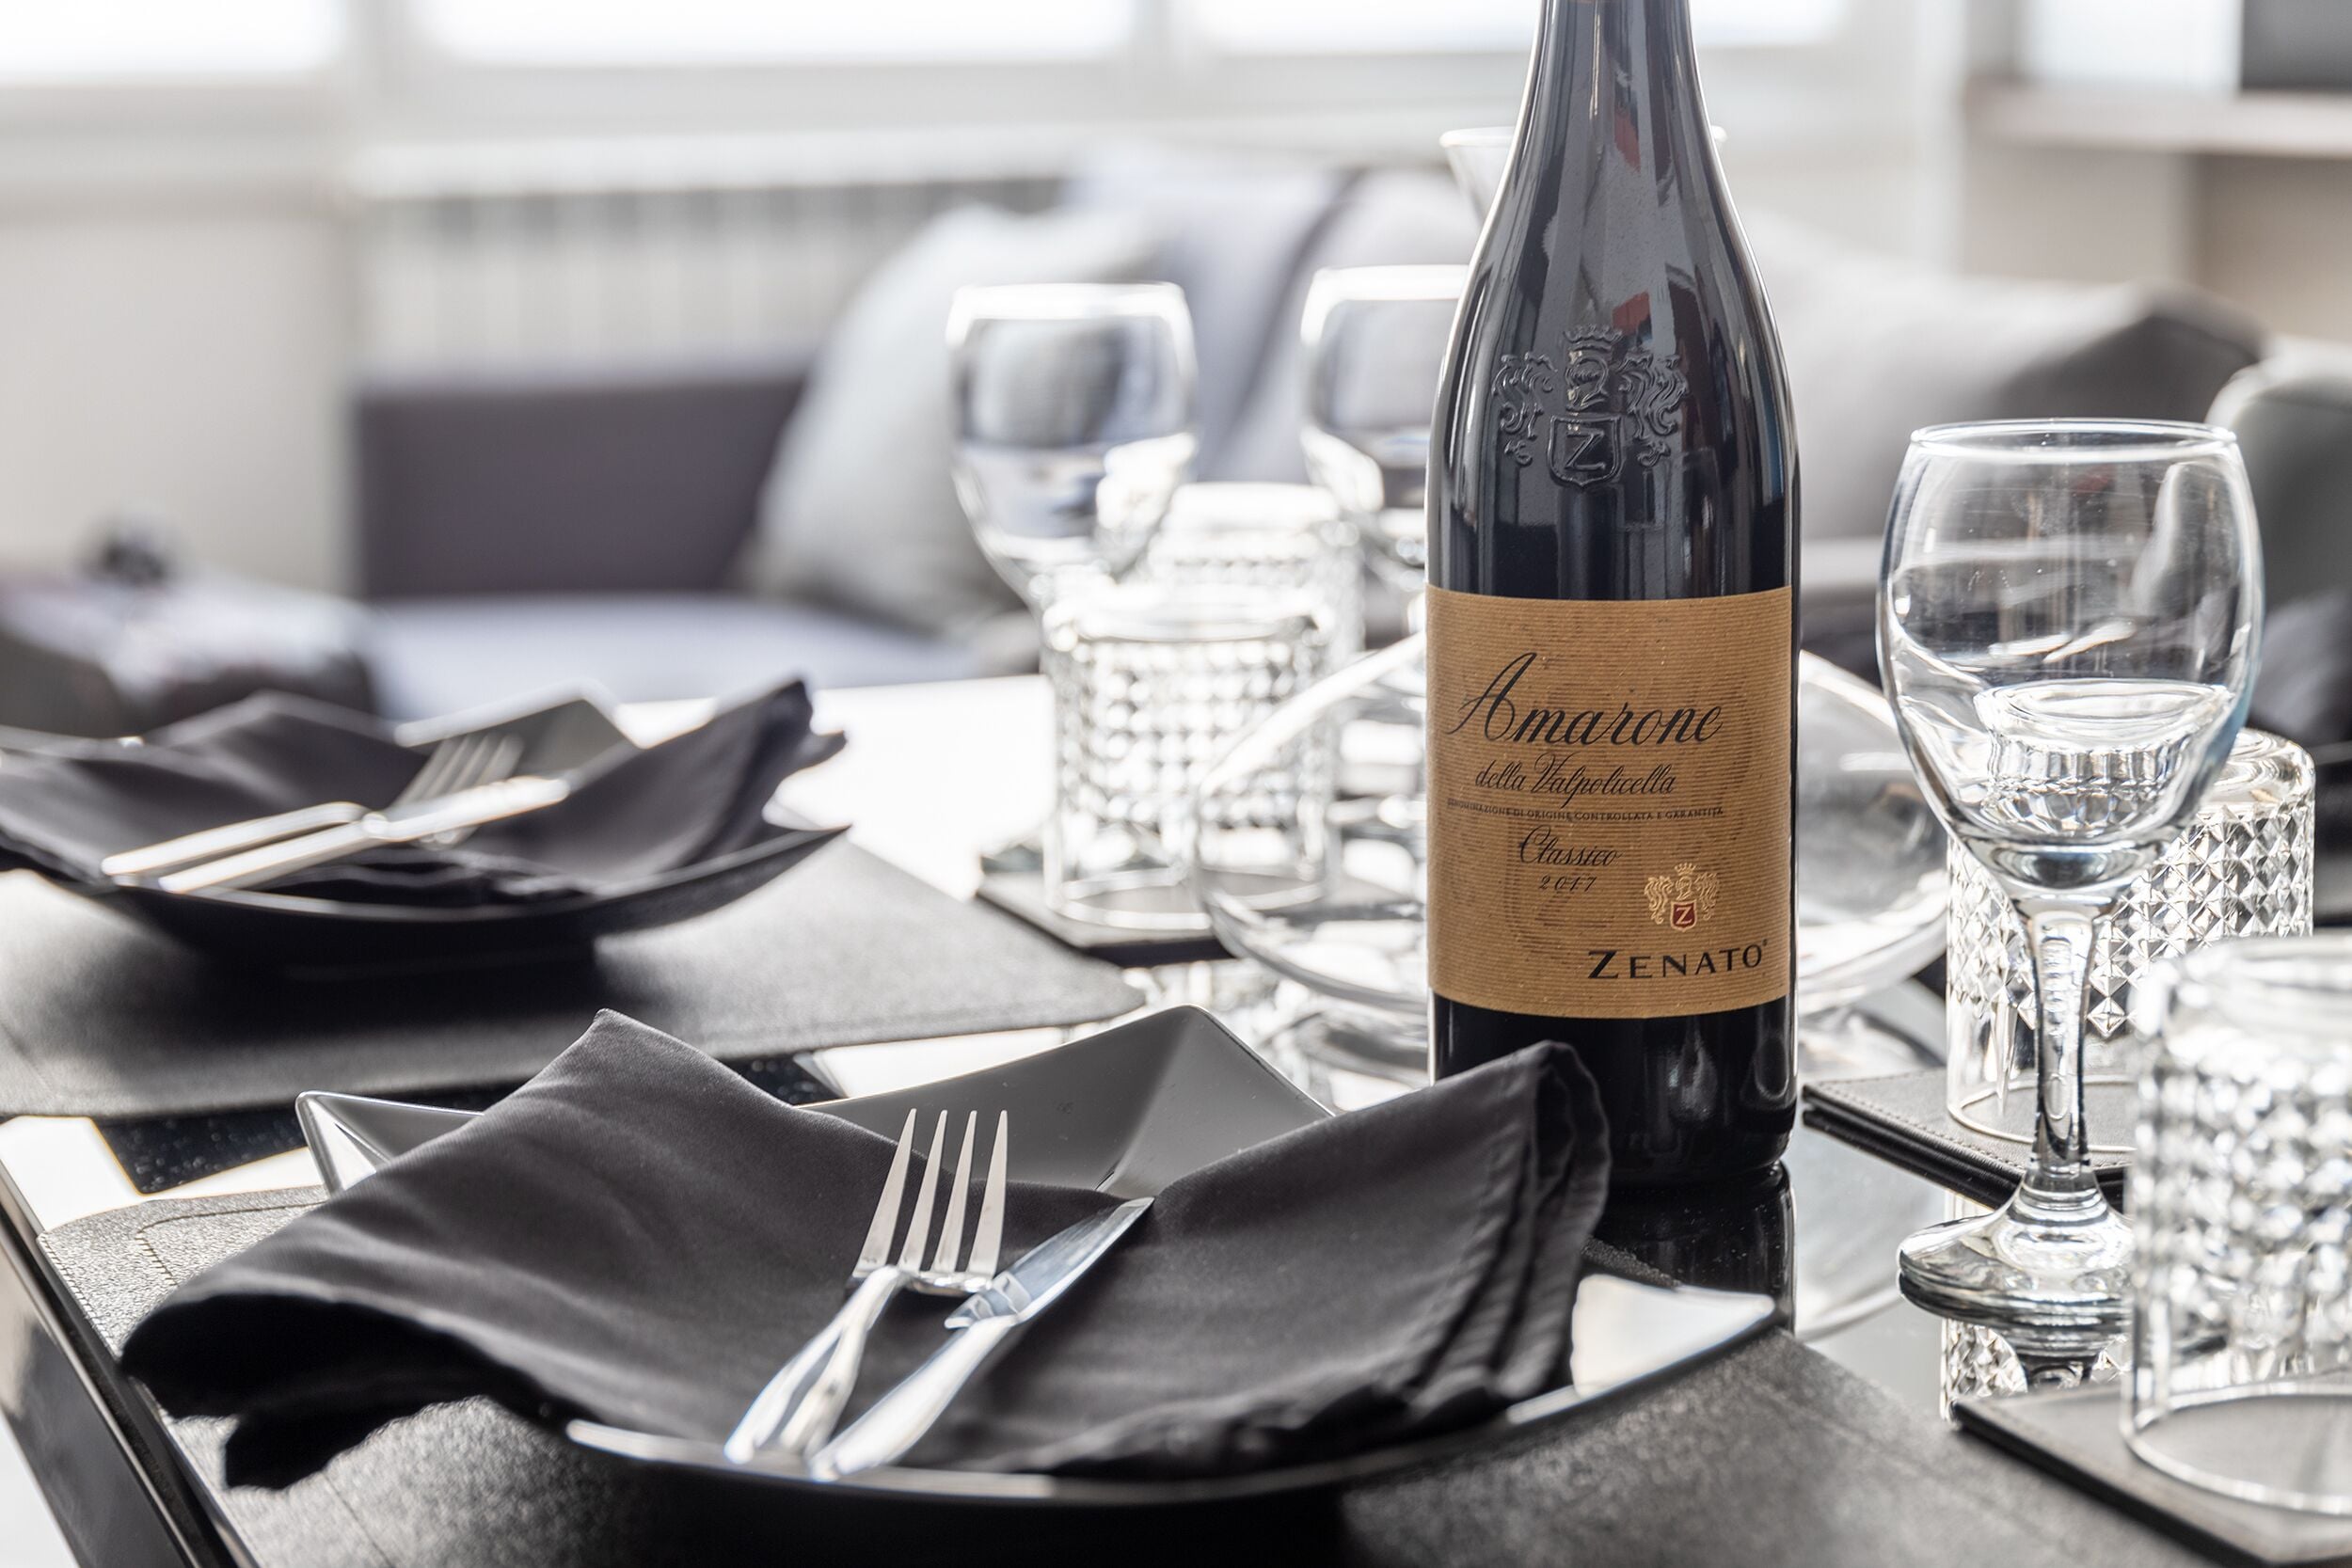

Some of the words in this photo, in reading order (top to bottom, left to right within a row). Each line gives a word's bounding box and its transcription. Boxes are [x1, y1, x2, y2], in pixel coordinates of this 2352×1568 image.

[1564, 432, 1606, 470] Z
[1446, 652, 1724, 746] Amarone
[1475, 759, 1526, 792] della
[1530, 752, 1677, 809] Valpolicella
[1527, 810, 1571, 821] ORIGINE
[1574, 811, 1653, 821] CONTROLLATA
[1518, 824, 1622, 867] Classico
[1539, 875, 1597, 893] 2017
[1676, 907, 1692, 925] Z
[1587, 944, 1763, 979] ZENATO
